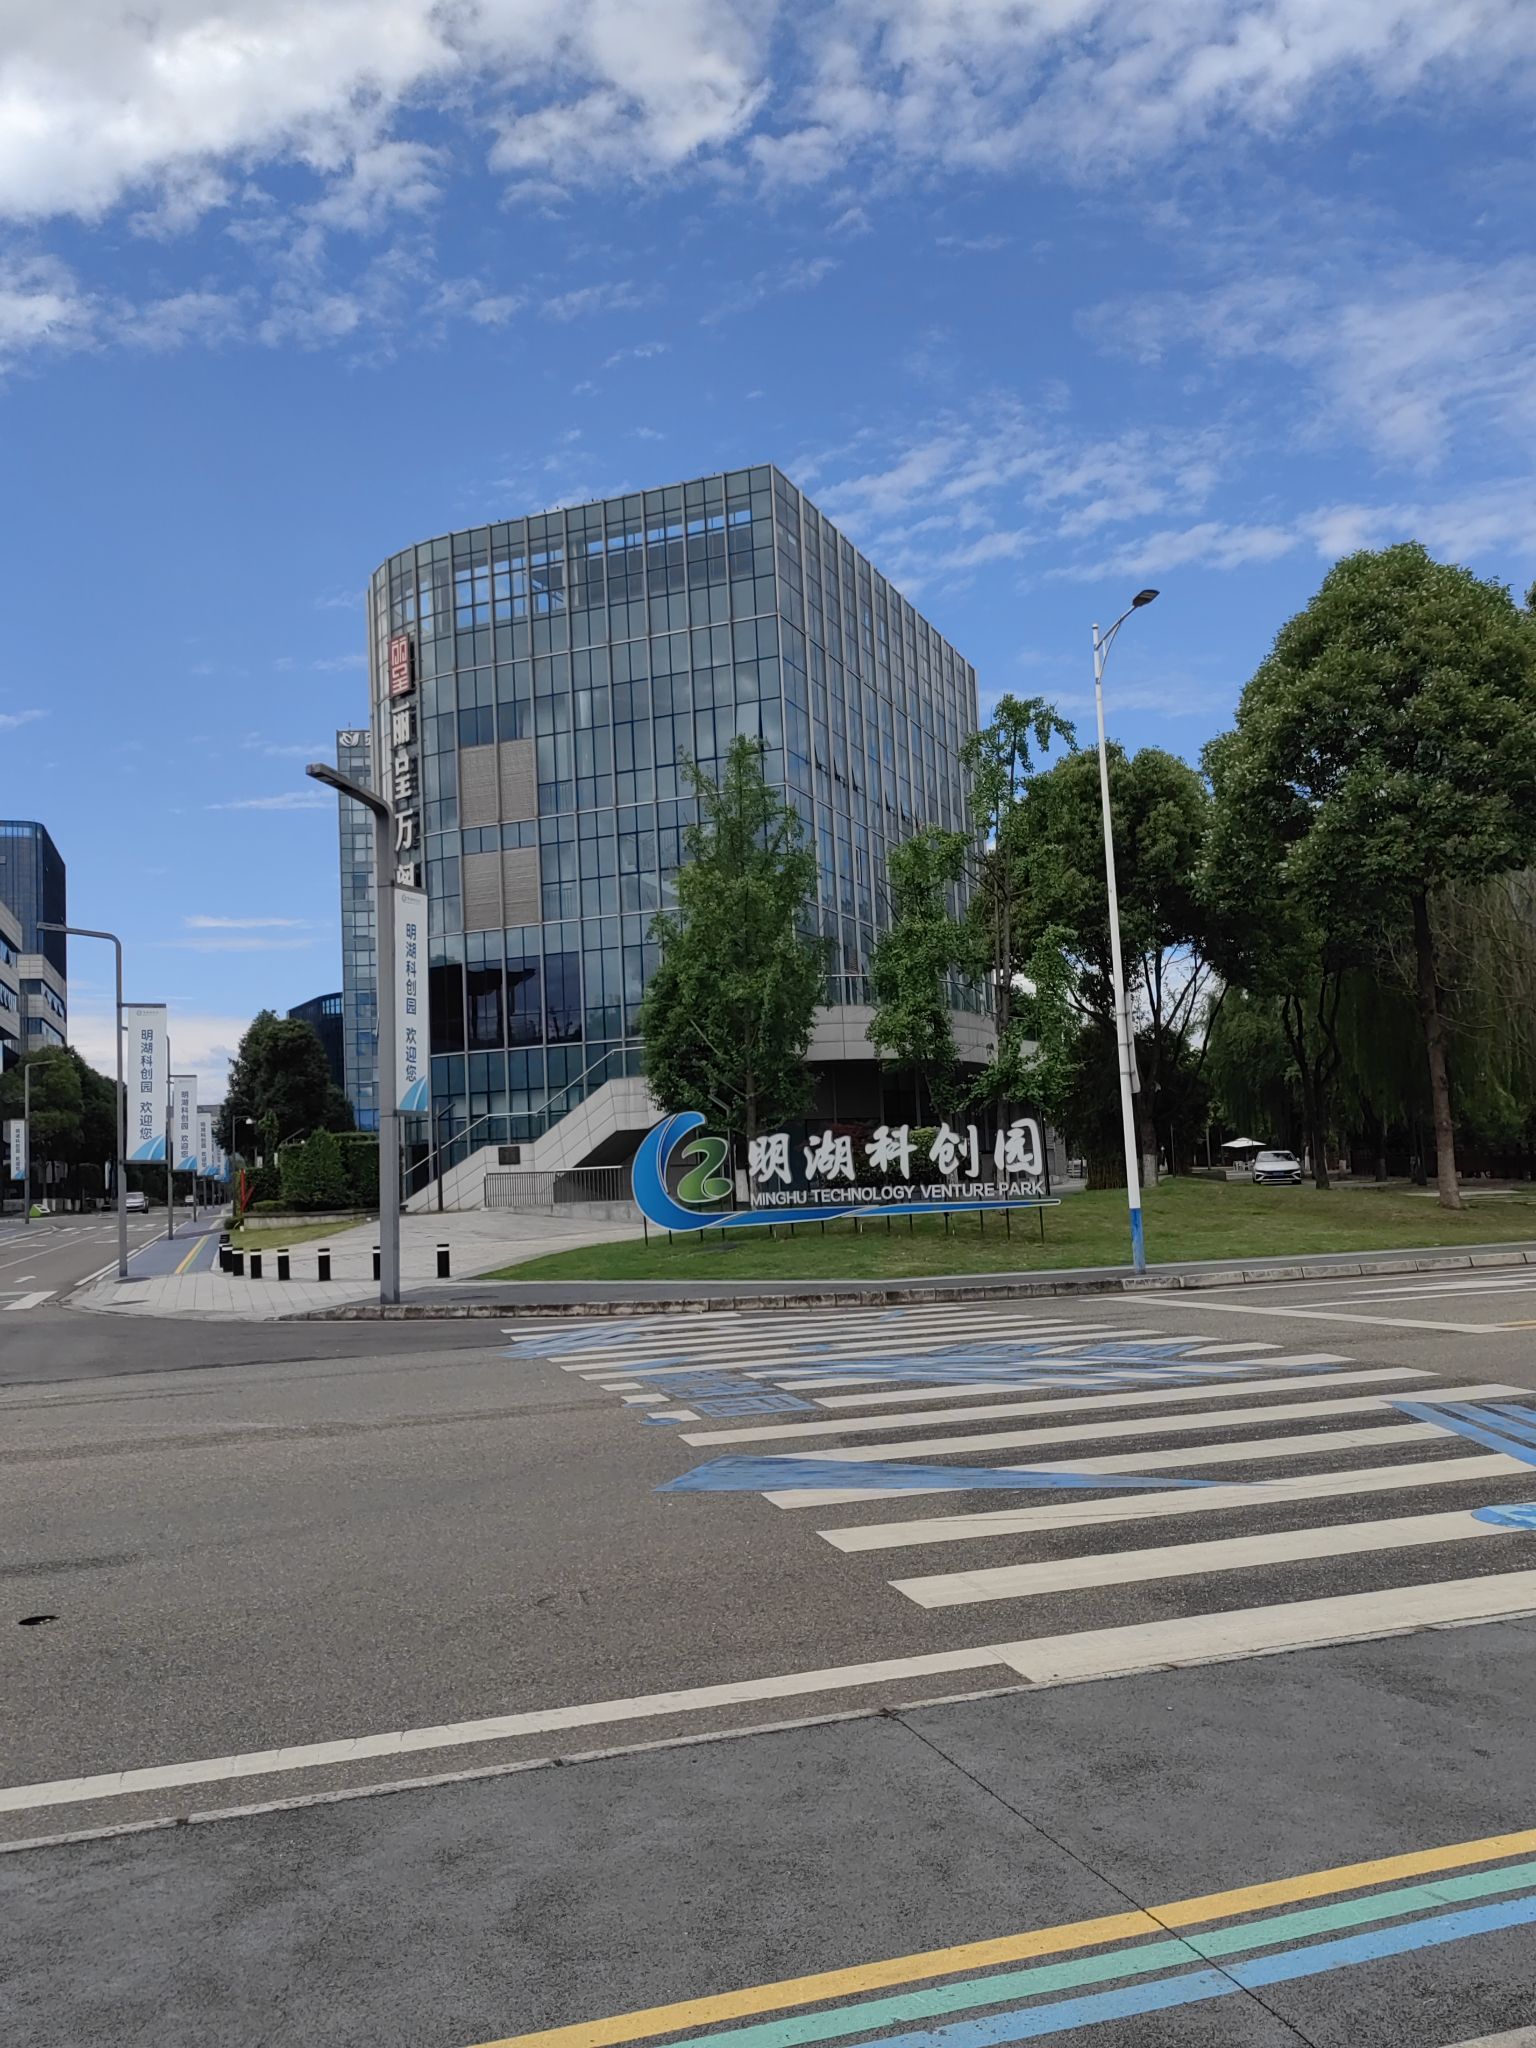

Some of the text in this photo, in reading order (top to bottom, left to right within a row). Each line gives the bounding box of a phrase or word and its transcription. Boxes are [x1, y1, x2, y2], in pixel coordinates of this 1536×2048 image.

[406, 923, 417, 1082] 明湖科创园 欢迎您
[140, 1029, 153, 1093] 明湖科创园
[140, 1101, 153, 1140] 欢迎您
[748, 1118, 1042, 1184] 明湖科创园
[751, 1180, 1045, 1206] MINGHU TECHNOLOGY VENTURE PARK
